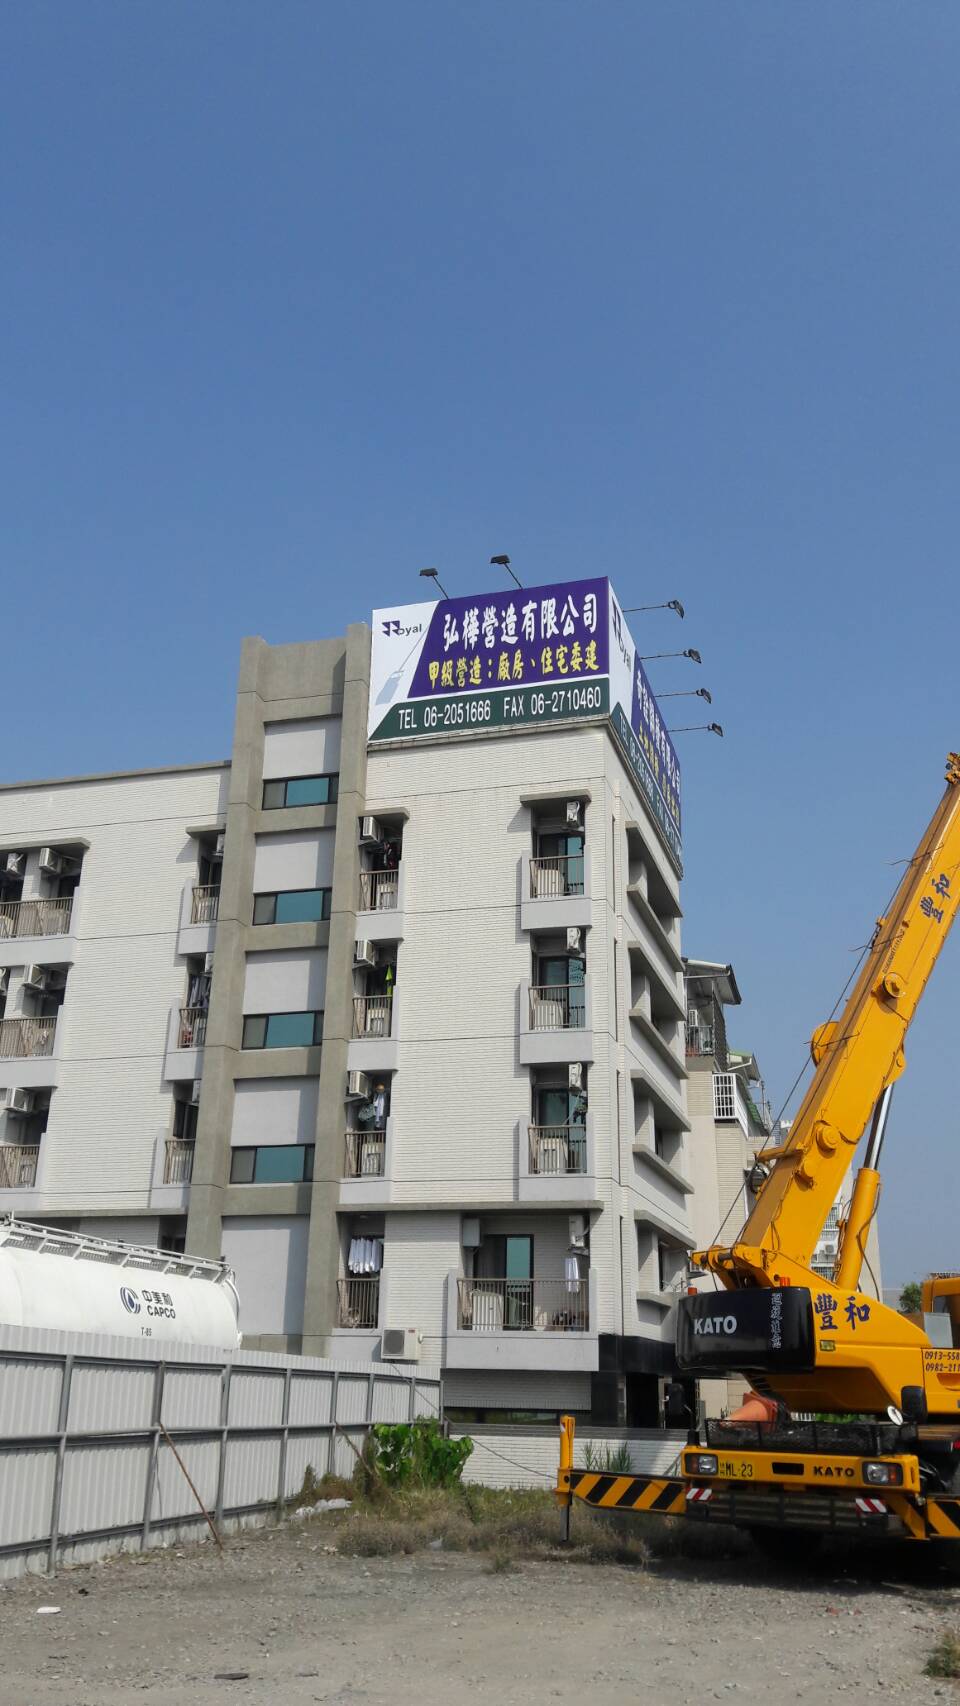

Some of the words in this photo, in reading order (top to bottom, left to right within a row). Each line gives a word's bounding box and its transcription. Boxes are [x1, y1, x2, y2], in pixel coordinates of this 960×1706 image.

[381, 620, 422, 638] Royal
[442, 593, 599, 652] 弘樺營造有限公司
[399, 709, 417, 730] TEL
[424, 700, 491, 727] 06-2051666
[503, 697, 525, 718] FAX
[531, 686, 601, 715] 06-2710460
[147, 1304, 176, 1319] CAPCO
[814, 1293, 871, 1331] 豐和
[693, 1315, 738, 1335] KATO
[813, 1465, 855, 1478] KATO
